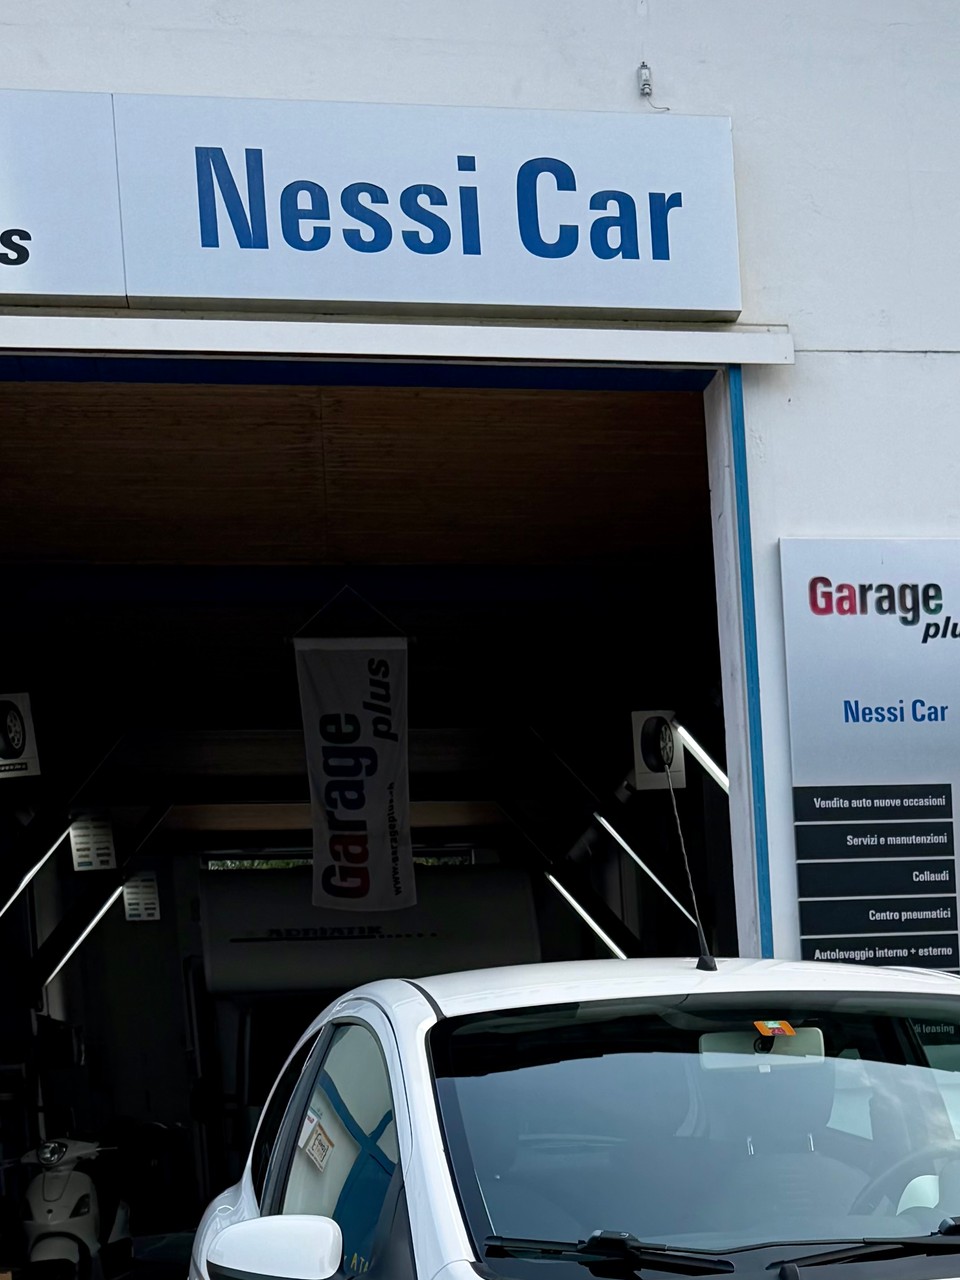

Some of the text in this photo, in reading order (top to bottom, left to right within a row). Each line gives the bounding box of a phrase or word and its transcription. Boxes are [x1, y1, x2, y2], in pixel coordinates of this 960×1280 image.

[194, 146, 682, 261] Nessi Car
[808, 576, 943, 626] Garage
[362, 657, 398, 742] plus
[843, 699, 948, 723] Nessi Car
[319, 712, 378, 899] Garage
[814, 796, 946, 808] Vendita auto nuove occasioni
[846, 835, 878, 846] Servizi
[887, 833, 947, 844] manutenzioni
[912, 871, 949, 881] Collaudi
[869, 908, 951, 921] Centro pneumatici
[814, 949, 874, 961] Autolavaggio
[876, 947, 908, 958] interno
[919, 947, 952, 956] esterno
[922, 1023, 954, 1034] leasing
